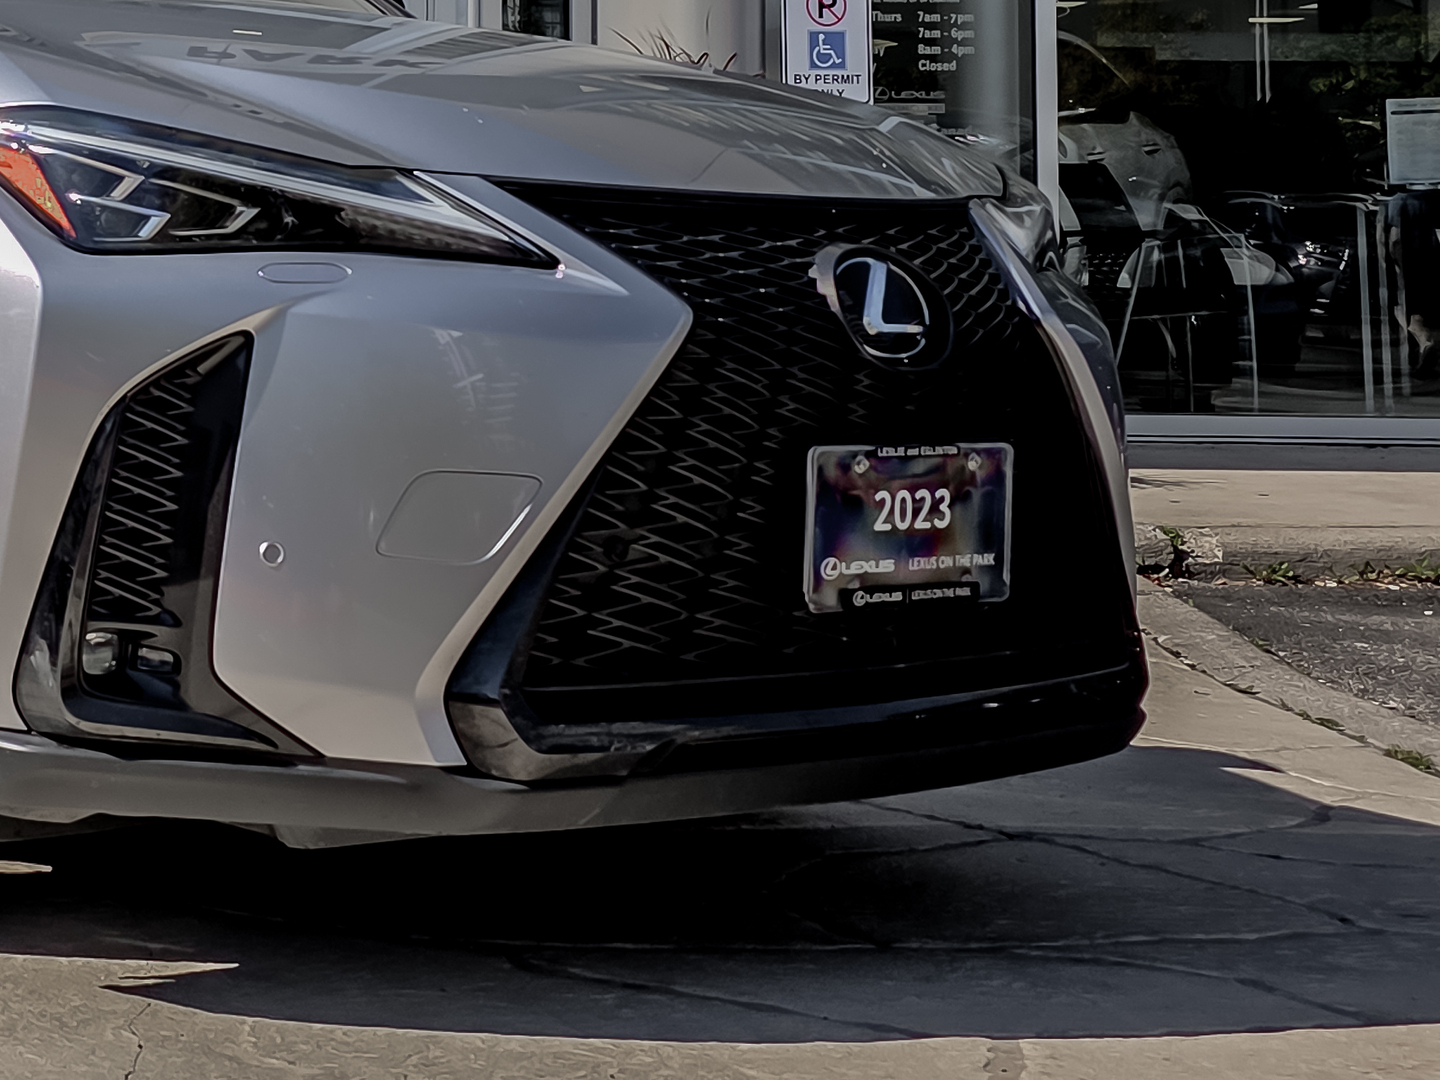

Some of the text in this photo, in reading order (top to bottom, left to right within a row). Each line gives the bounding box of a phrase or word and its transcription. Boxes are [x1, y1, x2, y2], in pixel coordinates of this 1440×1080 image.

[872, 11, 902, 22] Thurs
[917, 11, 940, 22] 7am
[950, 13, 974, 25] 7pm
[918, 27, 940, 38] 7am
[951, 27, 975, 41] 6pm
[918, 44, 941, 54] 8am
[951, 44, 975, 57] 4pm
[918, 60, 956, 71] Closed
[794, 74, 862, 85] BY PERMIT
[891, 90, 946, 99] LEXUS
[873, 488, 951, 531] 2023
[841, 553, 995, 575] LEXUS LEXUS ON THE PARK
